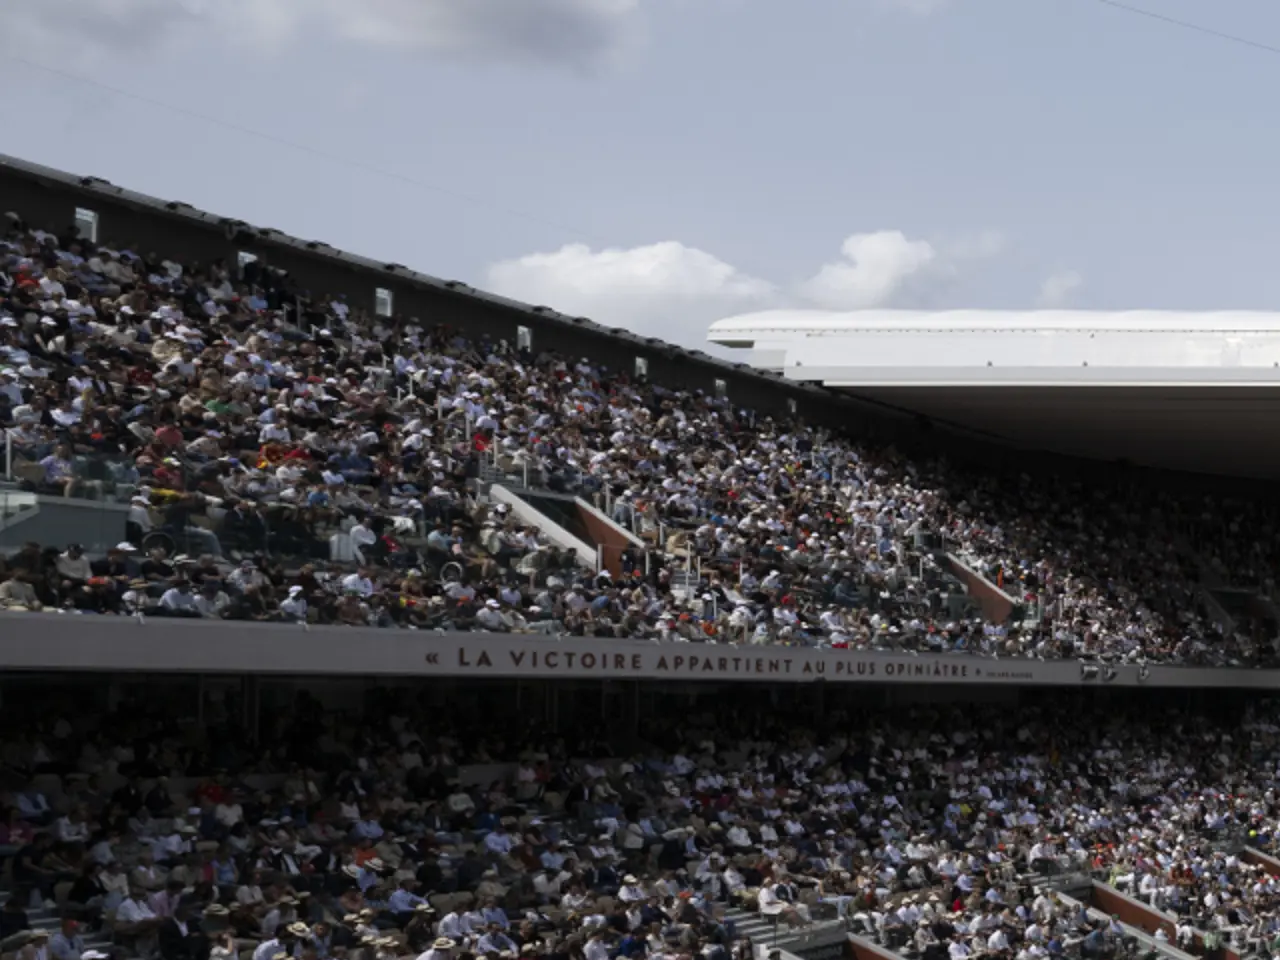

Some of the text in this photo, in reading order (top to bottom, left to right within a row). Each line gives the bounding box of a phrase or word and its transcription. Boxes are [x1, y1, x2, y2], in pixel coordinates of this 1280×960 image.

[458, 647, 493, 667] LA
[510, 650, 643, 670] VICTOIRE
[656, 655, 793, 673] APPARTIENT
[802, 660, 826, 674] AU
[835, 660, 876, 675] PLUS
[884, 659, 968, 677] OPINIÂTRE
